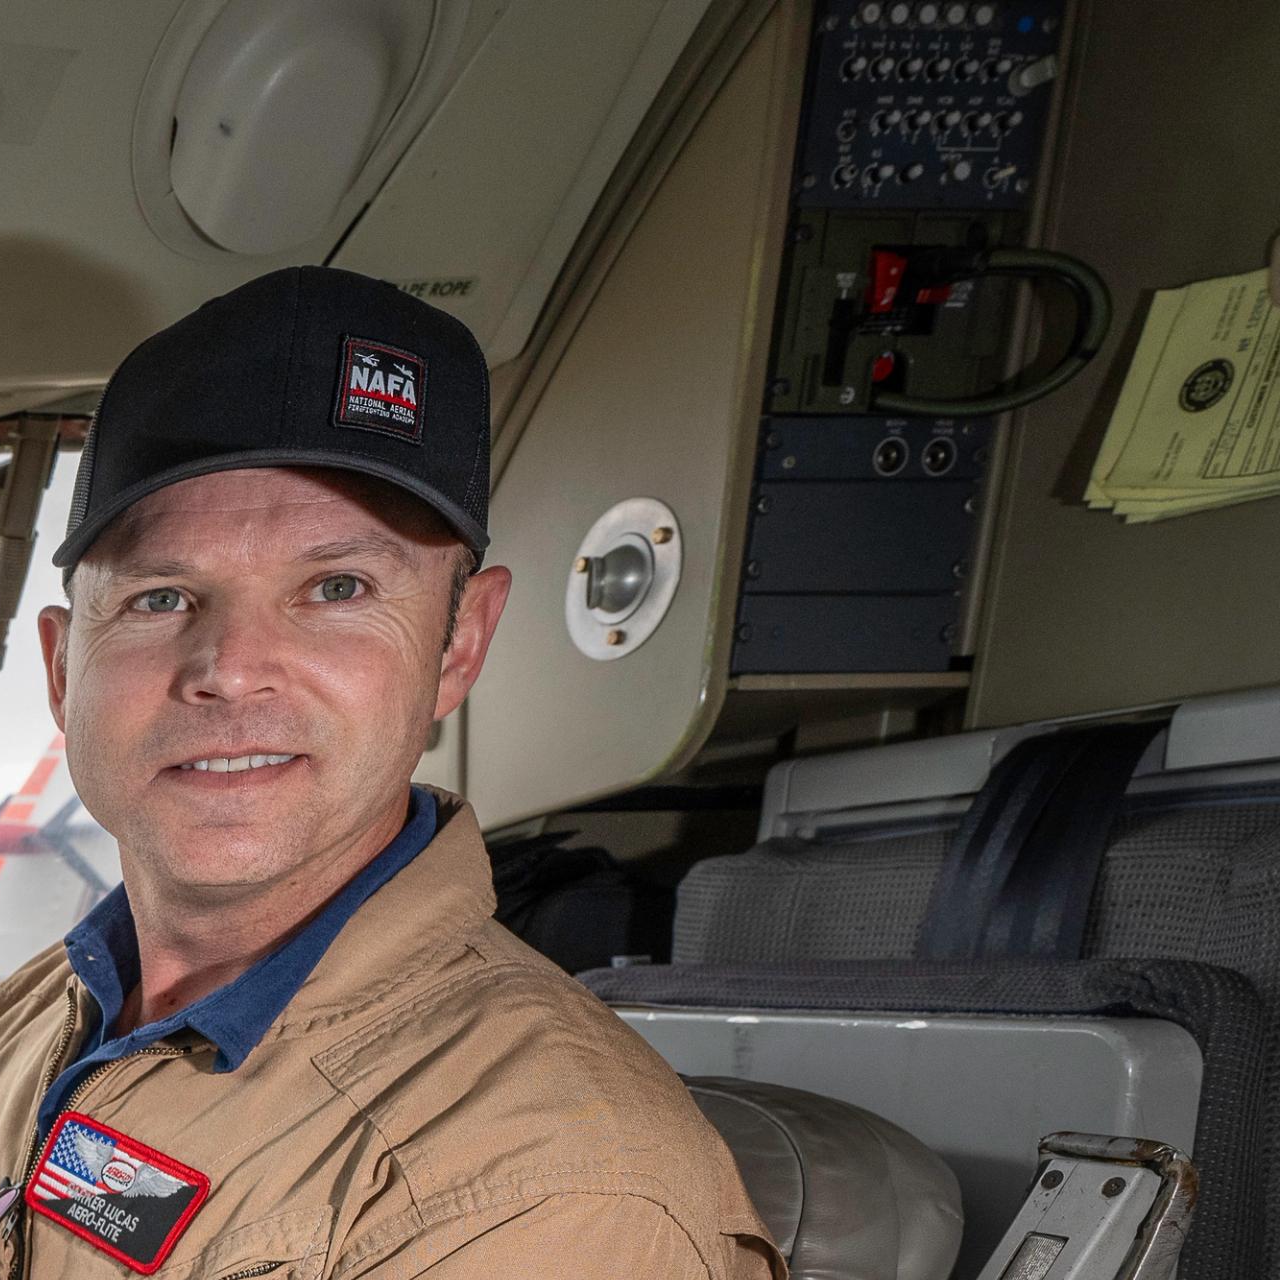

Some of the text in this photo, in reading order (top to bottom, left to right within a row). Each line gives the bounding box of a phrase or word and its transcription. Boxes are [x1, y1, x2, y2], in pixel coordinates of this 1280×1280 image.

[350, 365, 417, 406] NAFA
[349, 396, 415, 419] NATIONAL AERIAL
[67, 1202, 122, 1243] AERO-FLITE
[103, 1203, 140, 1233] LUCAS
